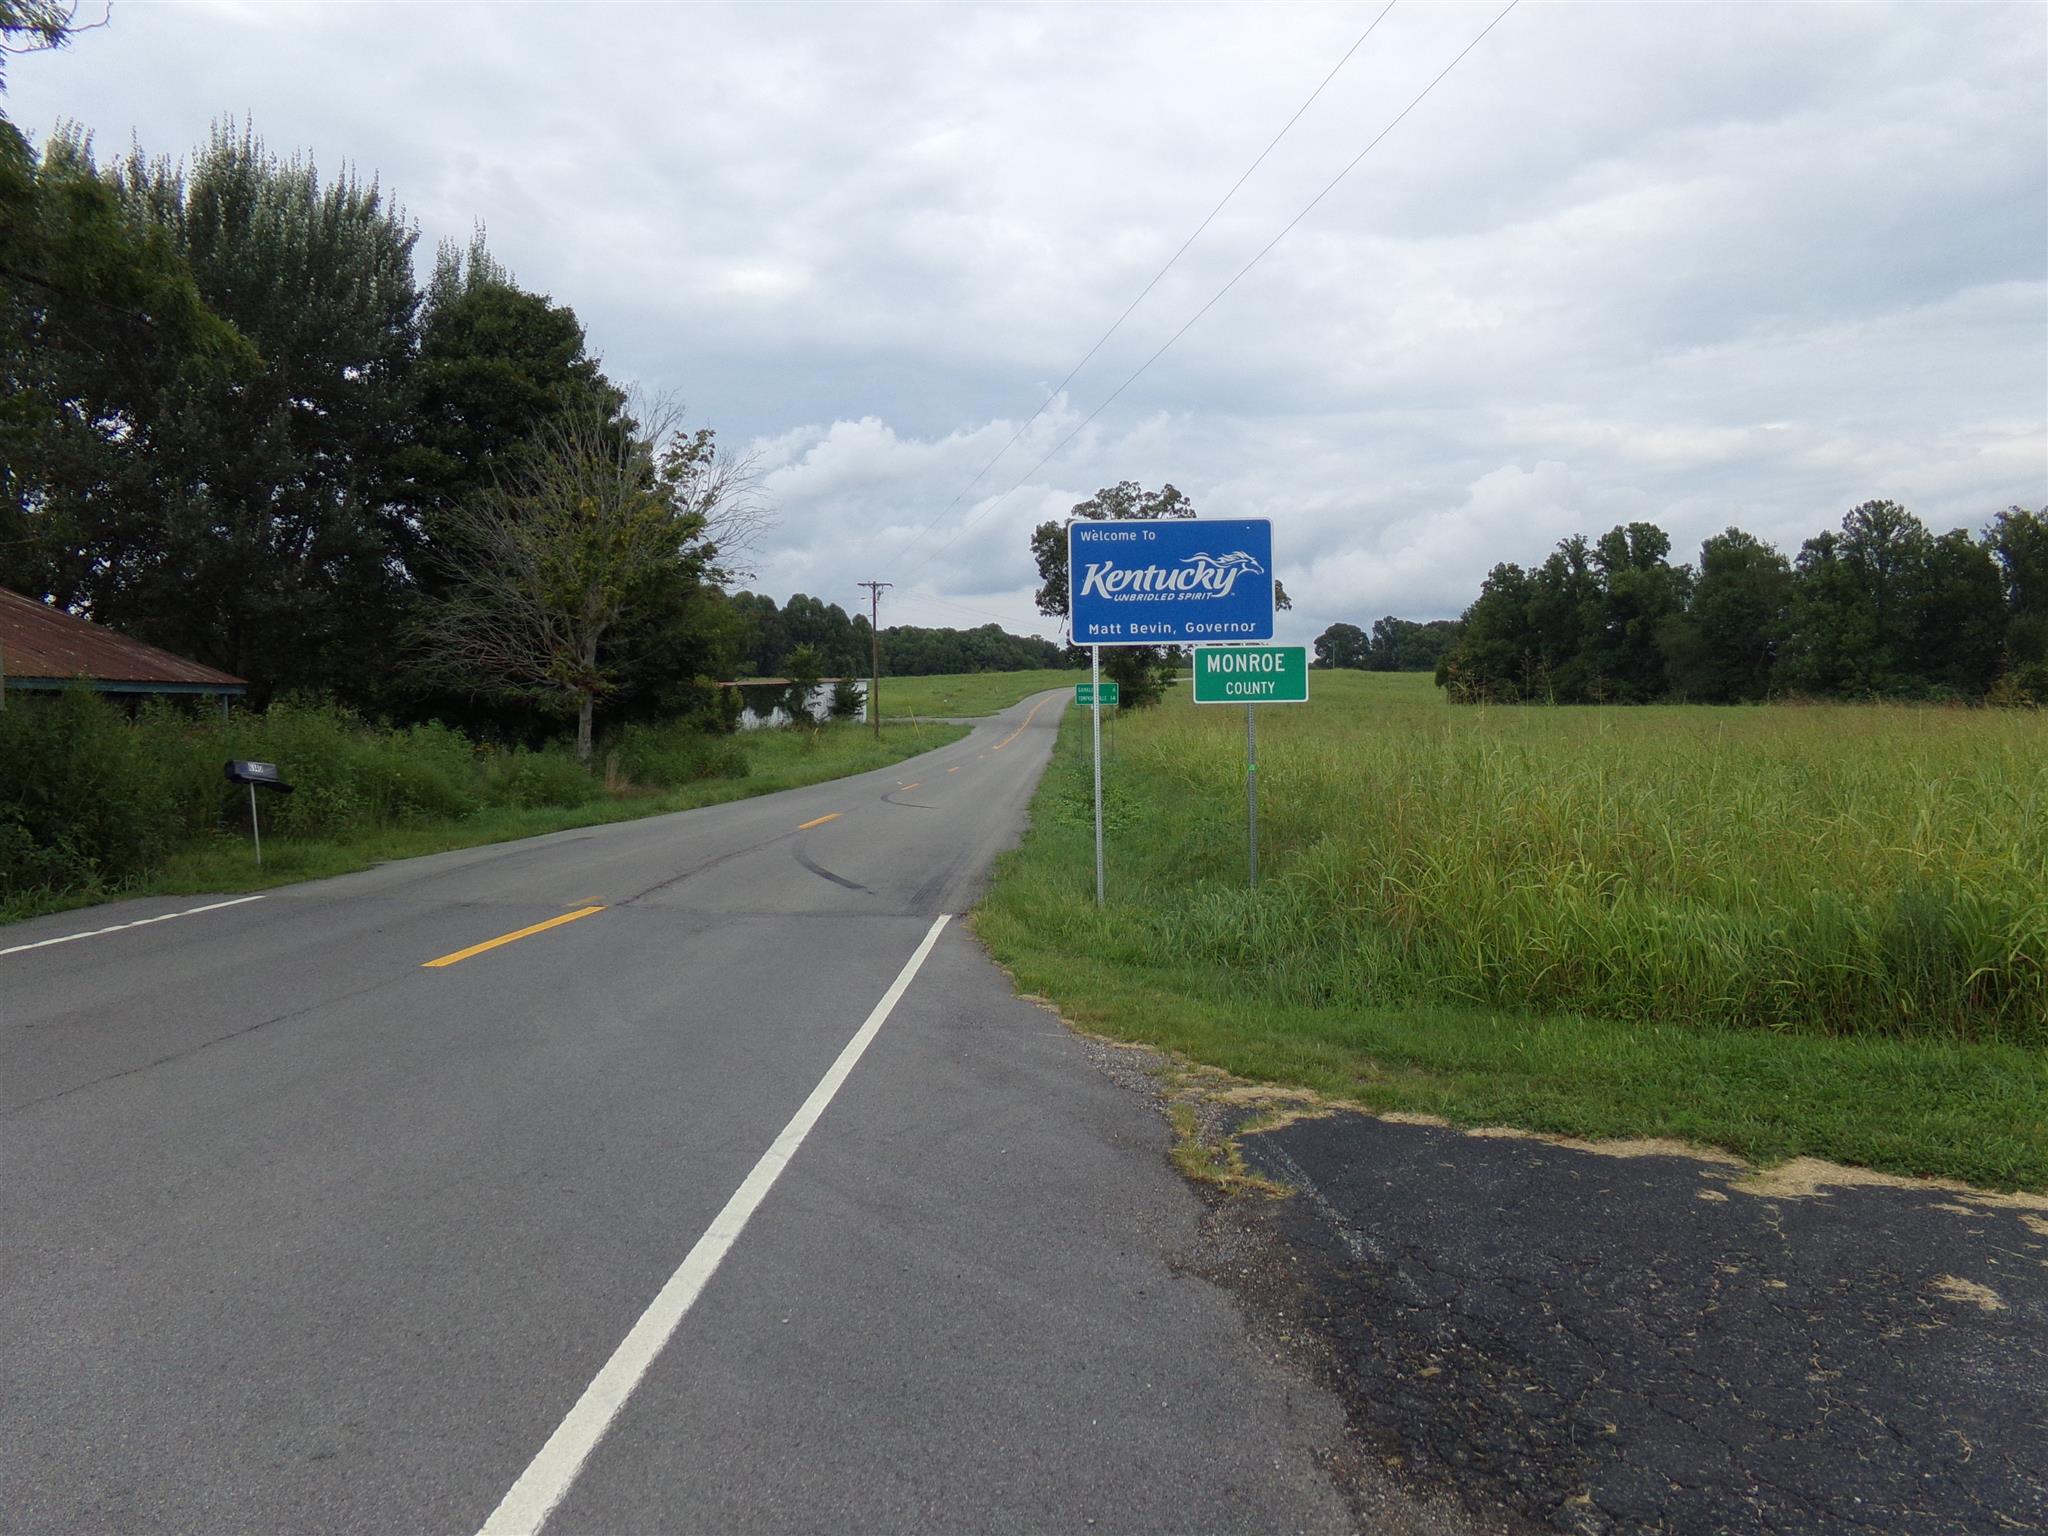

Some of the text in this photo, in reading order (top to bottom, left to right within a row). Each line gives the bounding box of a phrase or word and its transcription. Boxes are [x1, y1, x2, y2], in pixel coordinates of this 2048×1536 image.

[1080, 529, 1156, 541] Welcome To
[1080, 560, 1238, 599] Kentucky
[1113, 590, 1214, 602] UNBRIDLED SPIRIT
[1089, 621, 1257, 636] Matt Bevin, Governor
[1207, 653, 1286, 673] MONROE
[1226, 681, 1275, 695] COUNTY
